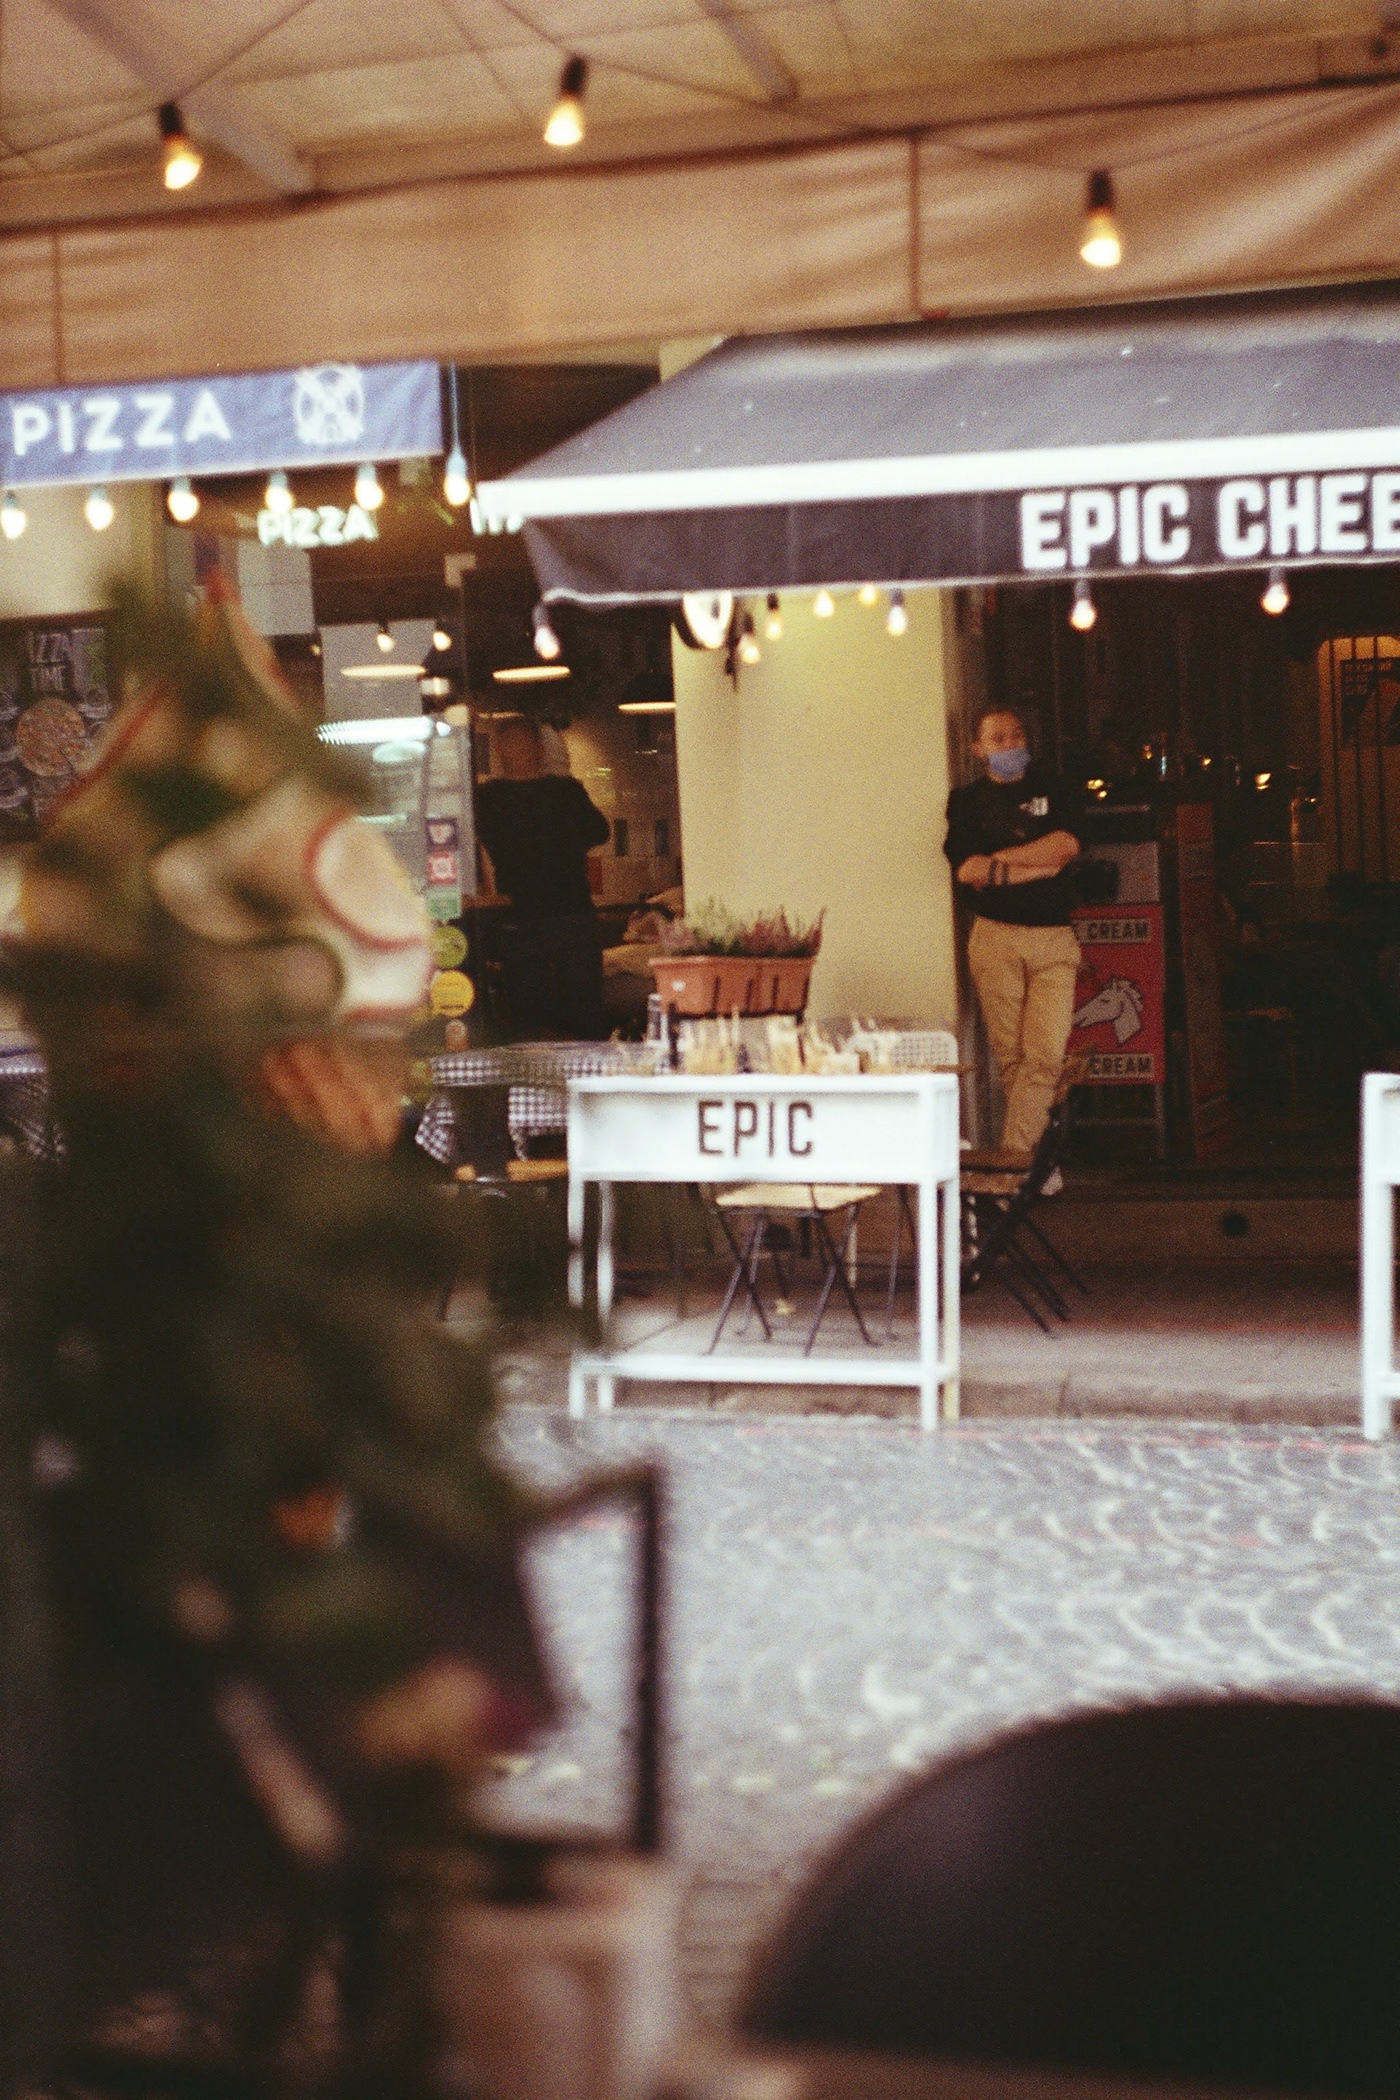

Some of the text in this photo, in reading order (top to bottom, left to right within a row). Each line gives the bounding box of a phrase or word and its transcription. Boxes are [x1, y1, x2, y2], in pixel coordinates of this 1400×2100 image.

[12, 387, 232, 456] PIZZA
[257, 504, 379, 548] PIZZA
[1020, 483, 1191, 571] EPIC
[1087, 921, 1149, 941] CREAM
[1088, 1056, 1152, 1075] CREAM
[698, 1100, 813, 1157] EPIC
